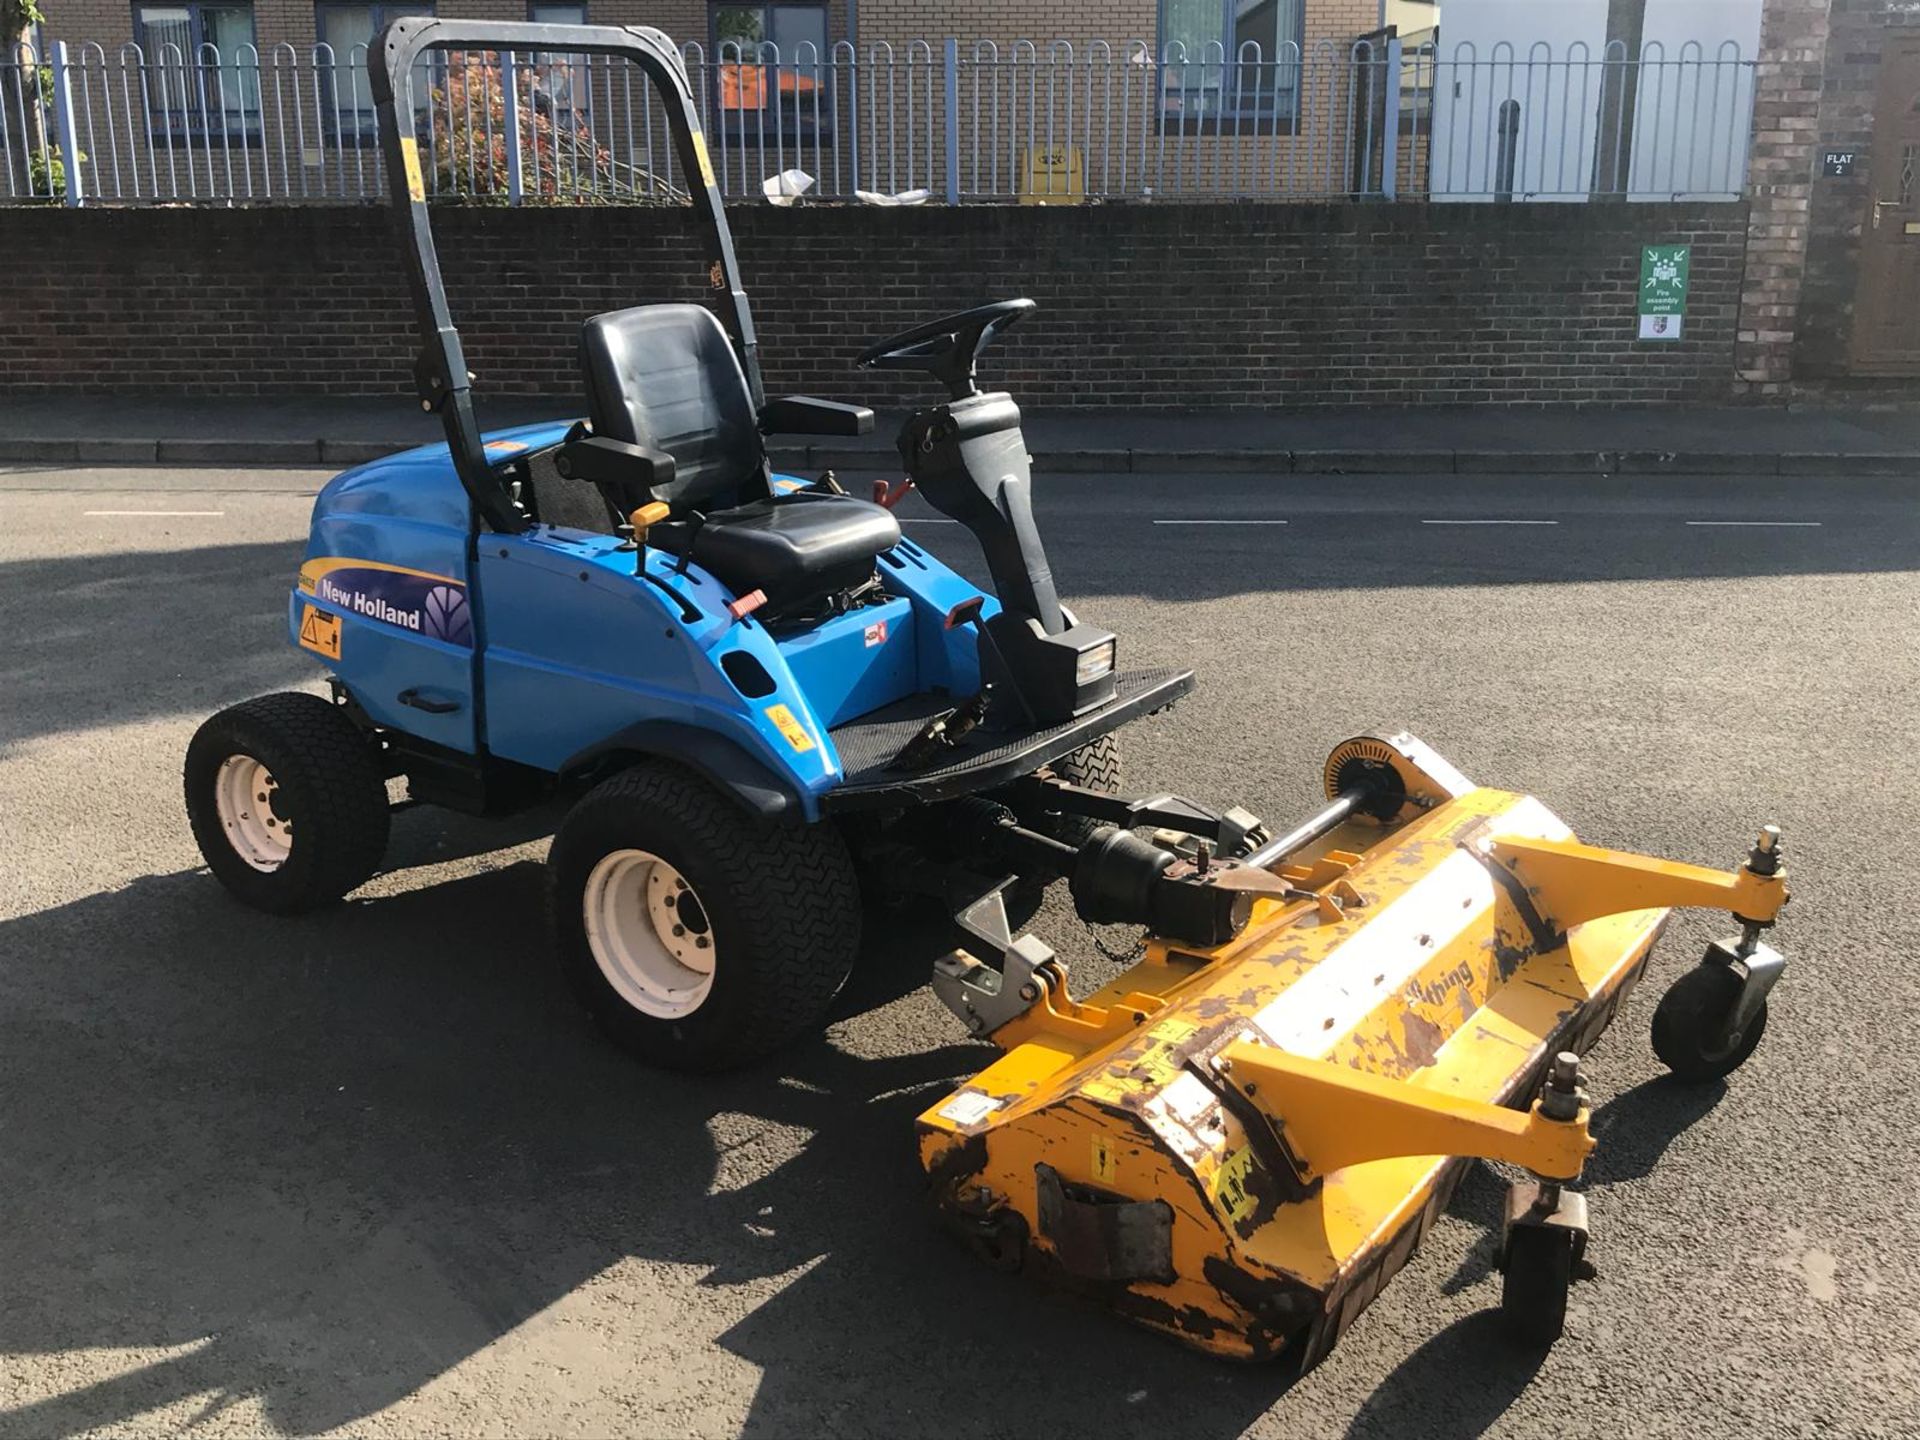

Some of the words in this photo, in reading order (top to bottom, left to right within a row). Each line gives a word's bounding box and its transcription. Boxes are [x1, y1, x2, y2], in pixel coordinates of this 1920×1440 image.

[1827, 154, 1853, 164] FLAT
[1836, 165, 1842, 174] 2
[1646, 297, 1680, 305] assembly
[322, 579, 351, 607] New
[354, 591, 420, 631] Holland
